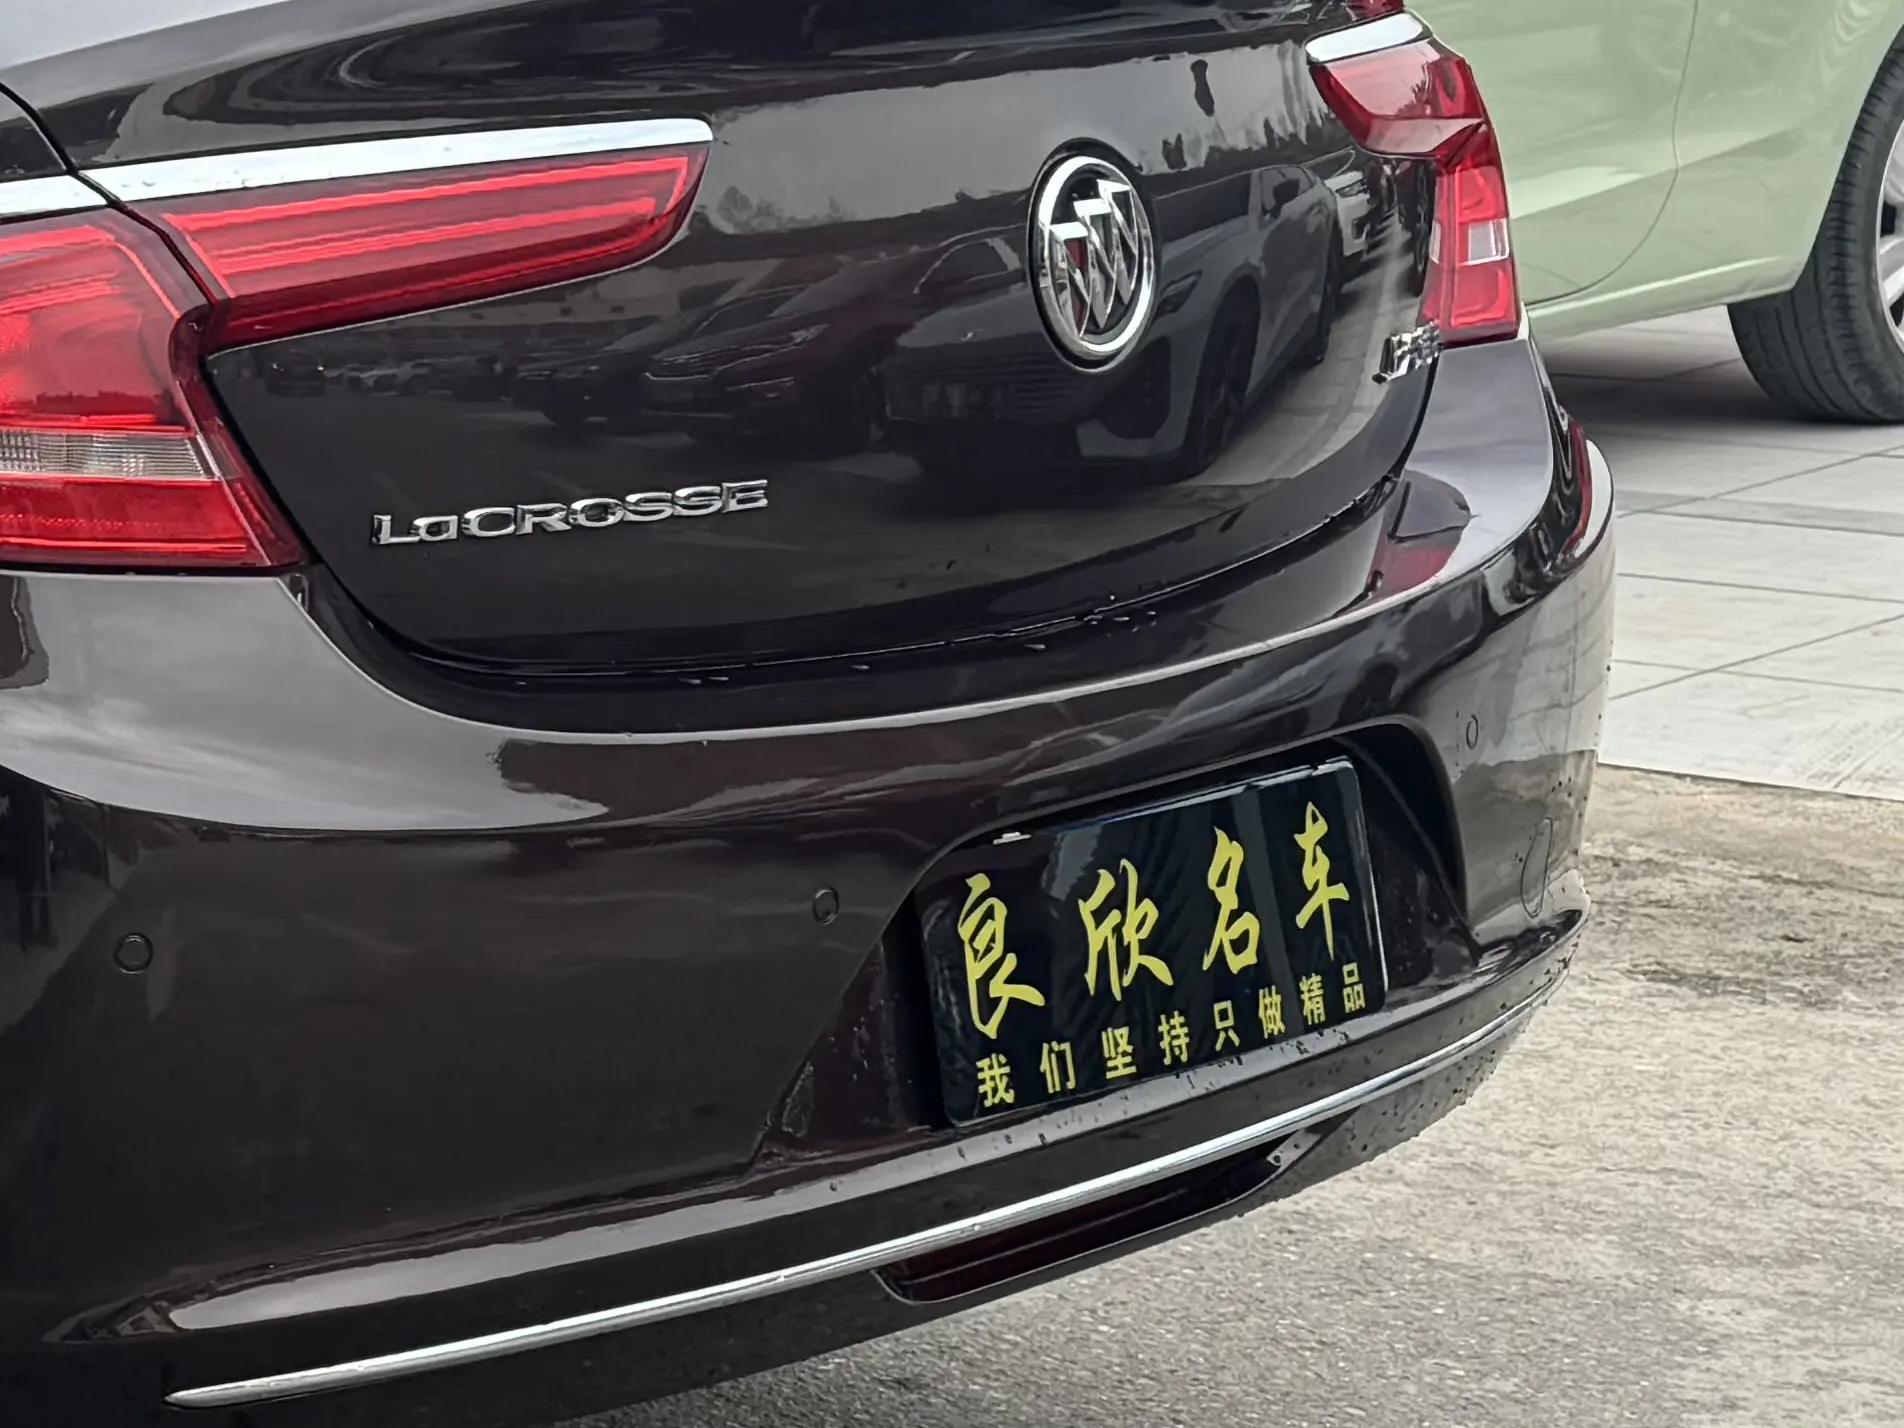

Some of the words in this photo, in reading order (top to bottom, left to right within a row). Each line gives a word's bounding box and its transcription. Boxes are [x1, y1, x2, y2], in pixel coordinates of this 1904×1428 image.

[956, 801, 1351, 1039] 良欣名车
[976, 962, 1366, 1108] 我们坚持只做精品
